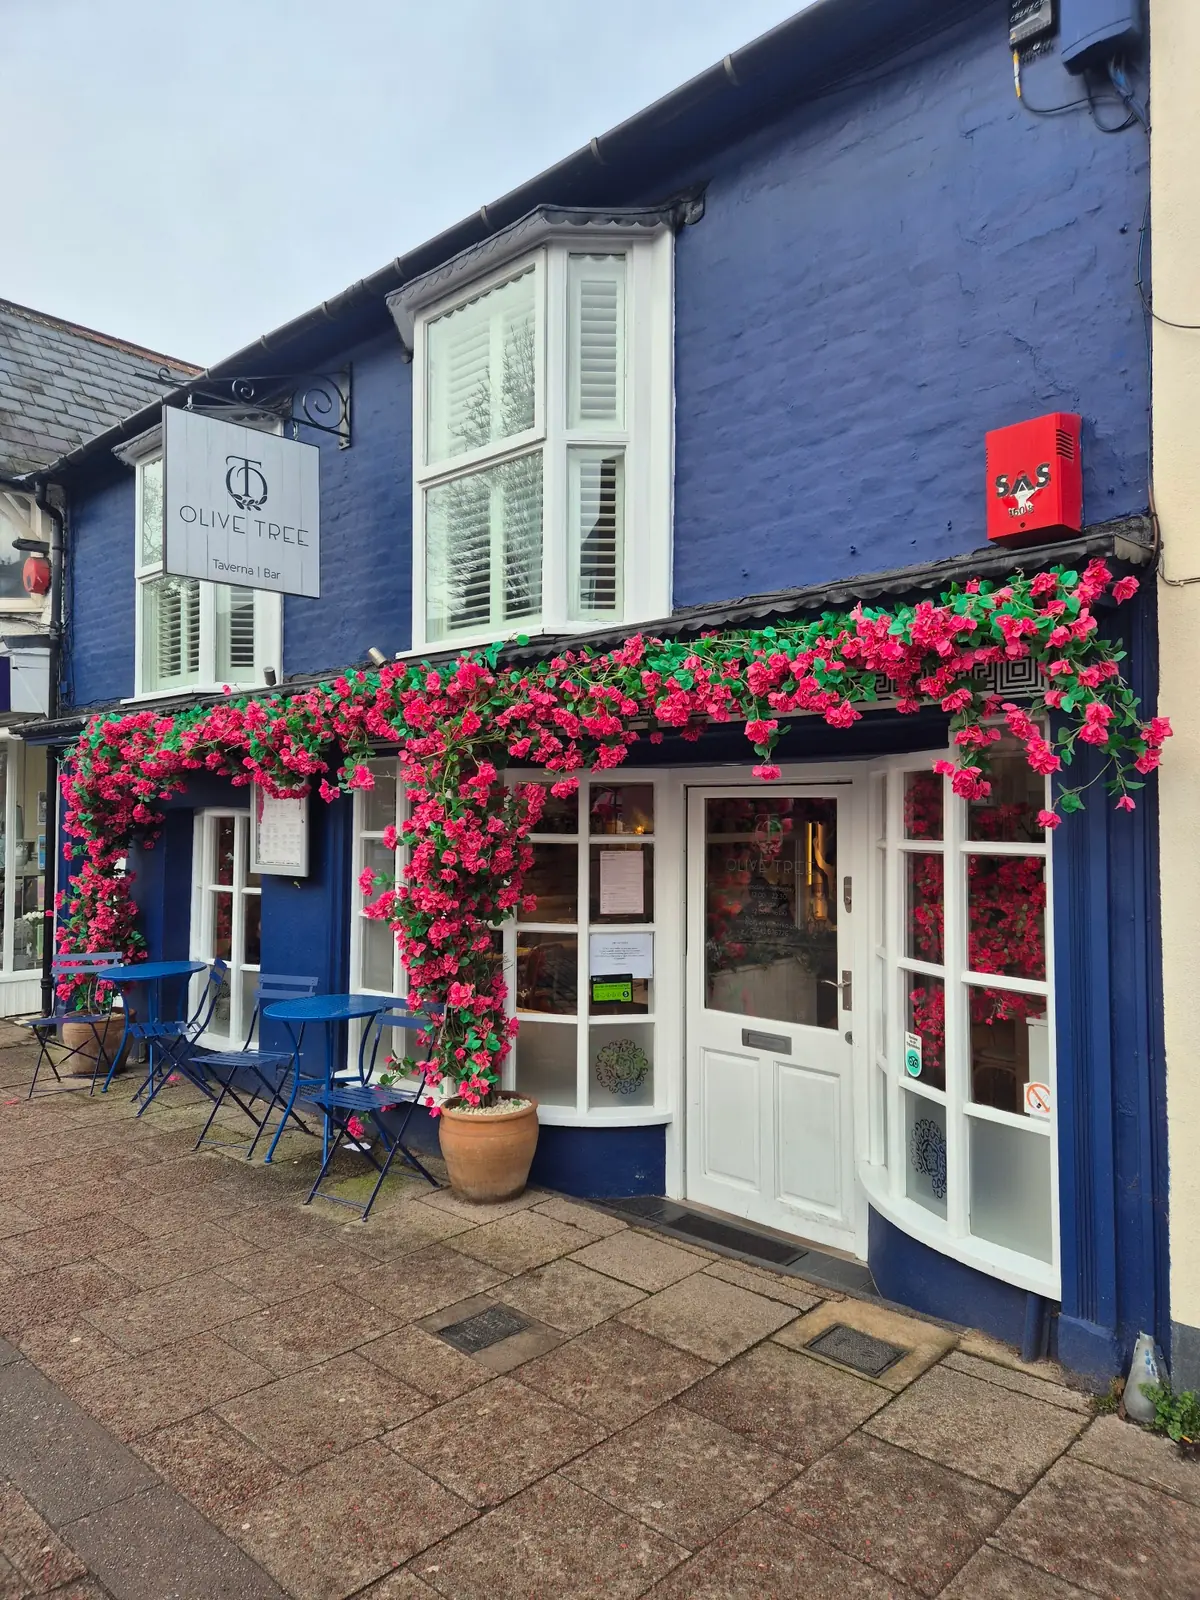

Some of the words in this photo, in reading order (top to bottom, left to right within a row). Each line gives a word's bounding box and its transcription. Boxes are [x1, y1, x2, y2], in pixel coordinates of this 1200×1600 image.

[995, 462, 1052, 498] SAS
[179, 505, 245, 534] OLIVE
[254, 519, 309, 547] TREE
[213, 558, 254, 576] Taverna
[264, 568, 282, 580] Bar
[727, 858, 767, 873] OLIVE
